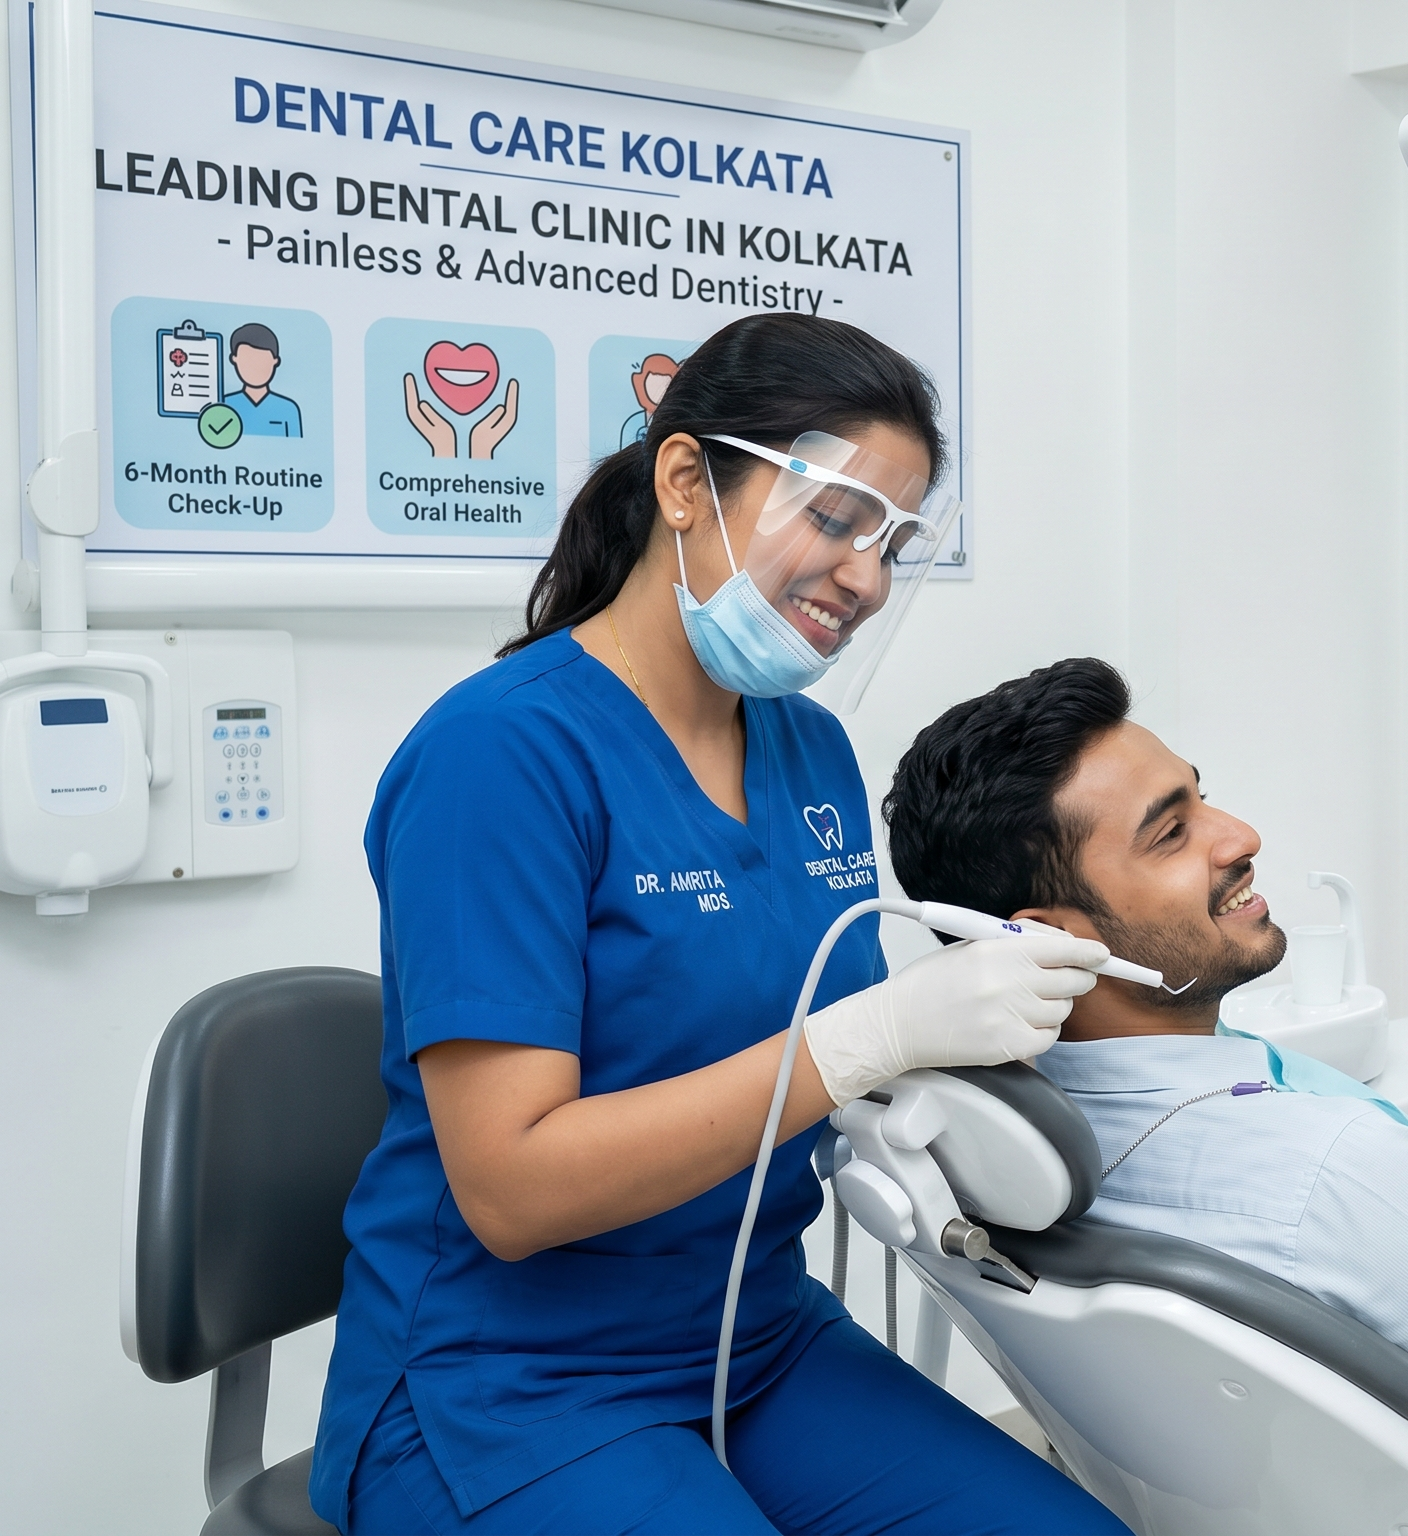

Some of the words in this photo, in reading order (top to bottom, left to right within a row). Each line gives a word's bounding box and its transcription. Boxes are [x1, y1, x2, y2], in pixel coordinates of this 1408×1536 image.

[234, 76, 453, 150] DENTAL
[469, 111, 606, 170] CARE
[622, 130, 833, 199] KOLKATA
[95, 148, 318, 212] LEADING
[336, 176, 517, 234] DENTAL
[531, 200, 672, 250] CLINIC
[686, 217, 725, 256] IN
[739, 223, 913, 277] KOLKATA
[247, 223, 422, 276] Painless
[436, 243, 462, 280] &
[474, 248, 658, 298] Advanced
[672, 267, 823, 316] Dentistry
[124, 461, 227, 485] 6-Month
[235, 465, 323, 489] Routine
[379, 471, 545, 497] Comprehensive
[168, 492, 283, 521] Check-Up
[404, 501, 447, 522] Oral
[454, 502, 522, 524] Health
[847, 850, 875, 870] CARE
[635, 873, 665, 895] DR.
[670, 869, 726, 892] AMRITA
[825, 869, 875, 891] KOLKATA
[697, 892, 734, 913] MDS.
